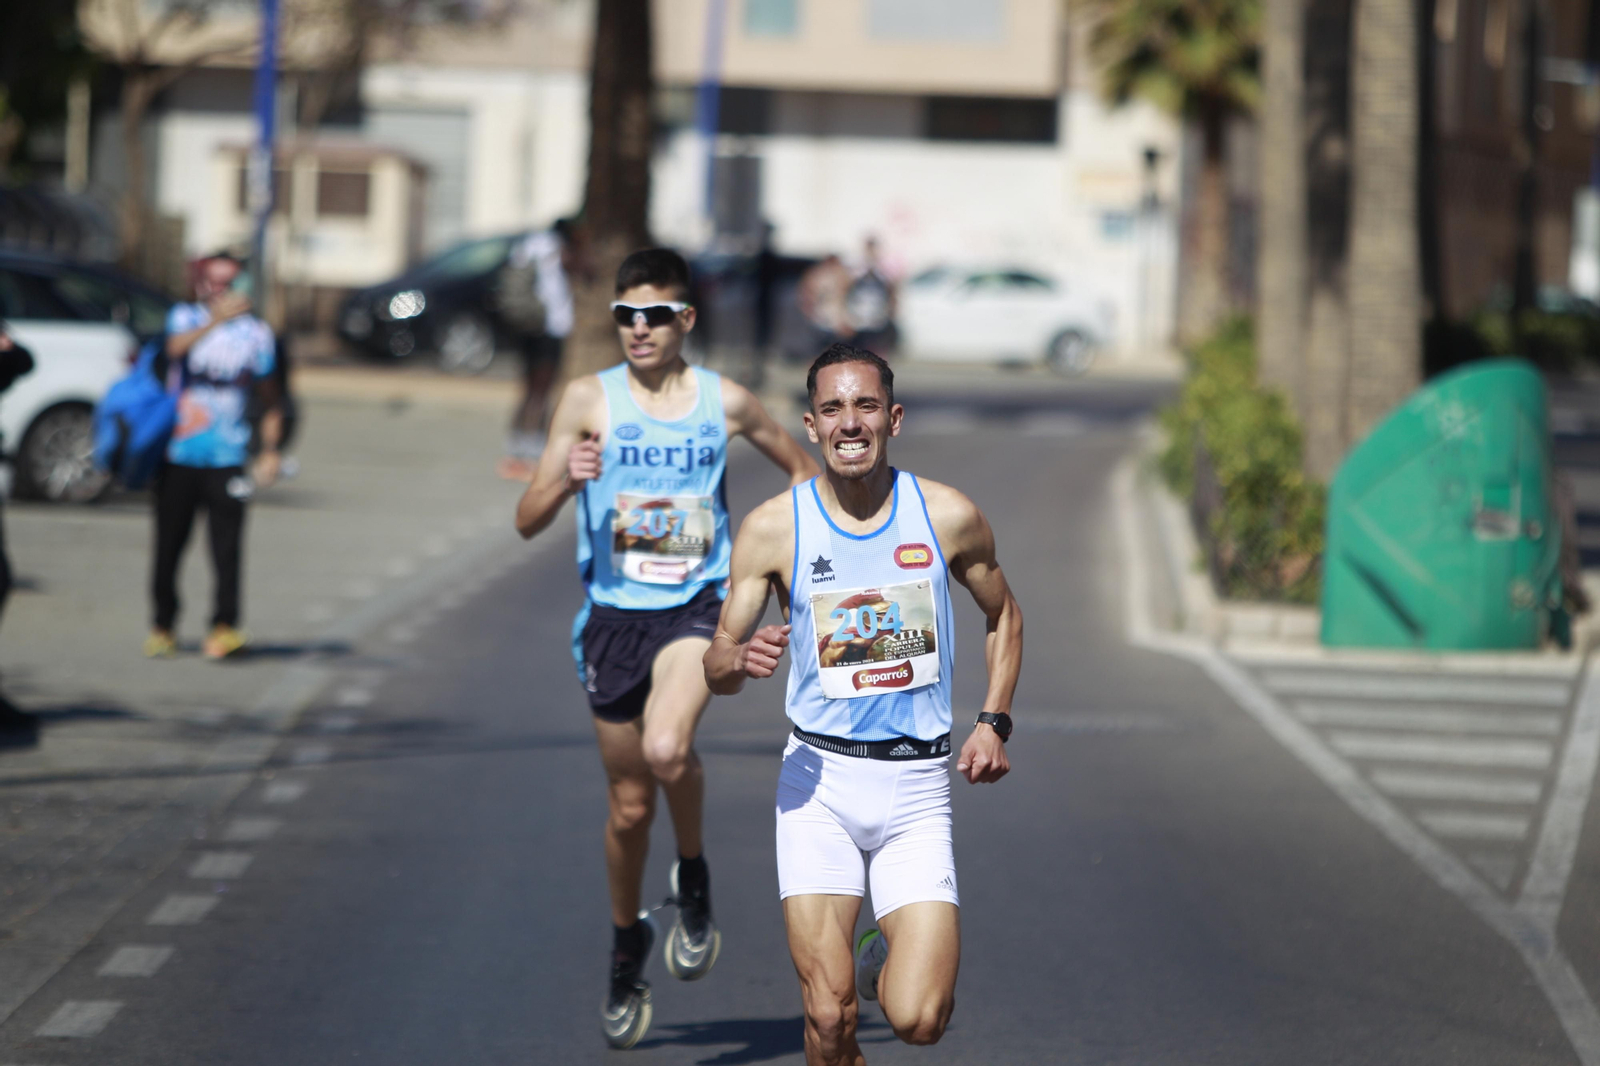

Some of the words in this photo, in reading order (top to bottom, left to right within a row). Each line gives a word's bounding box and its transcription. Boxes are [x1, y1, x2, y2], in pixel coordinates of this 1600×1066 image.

[619, 438, 715, 475] nerja
[626, 508, 688, 538] 207
[811, 574, 836, 584] luanvi
[829, 601, 904, 642] 204
[883, 629, 924, 643] XIII
[884, 637, 925, 648] CARRERA
[884, 642, 925, 652] POPULAR
